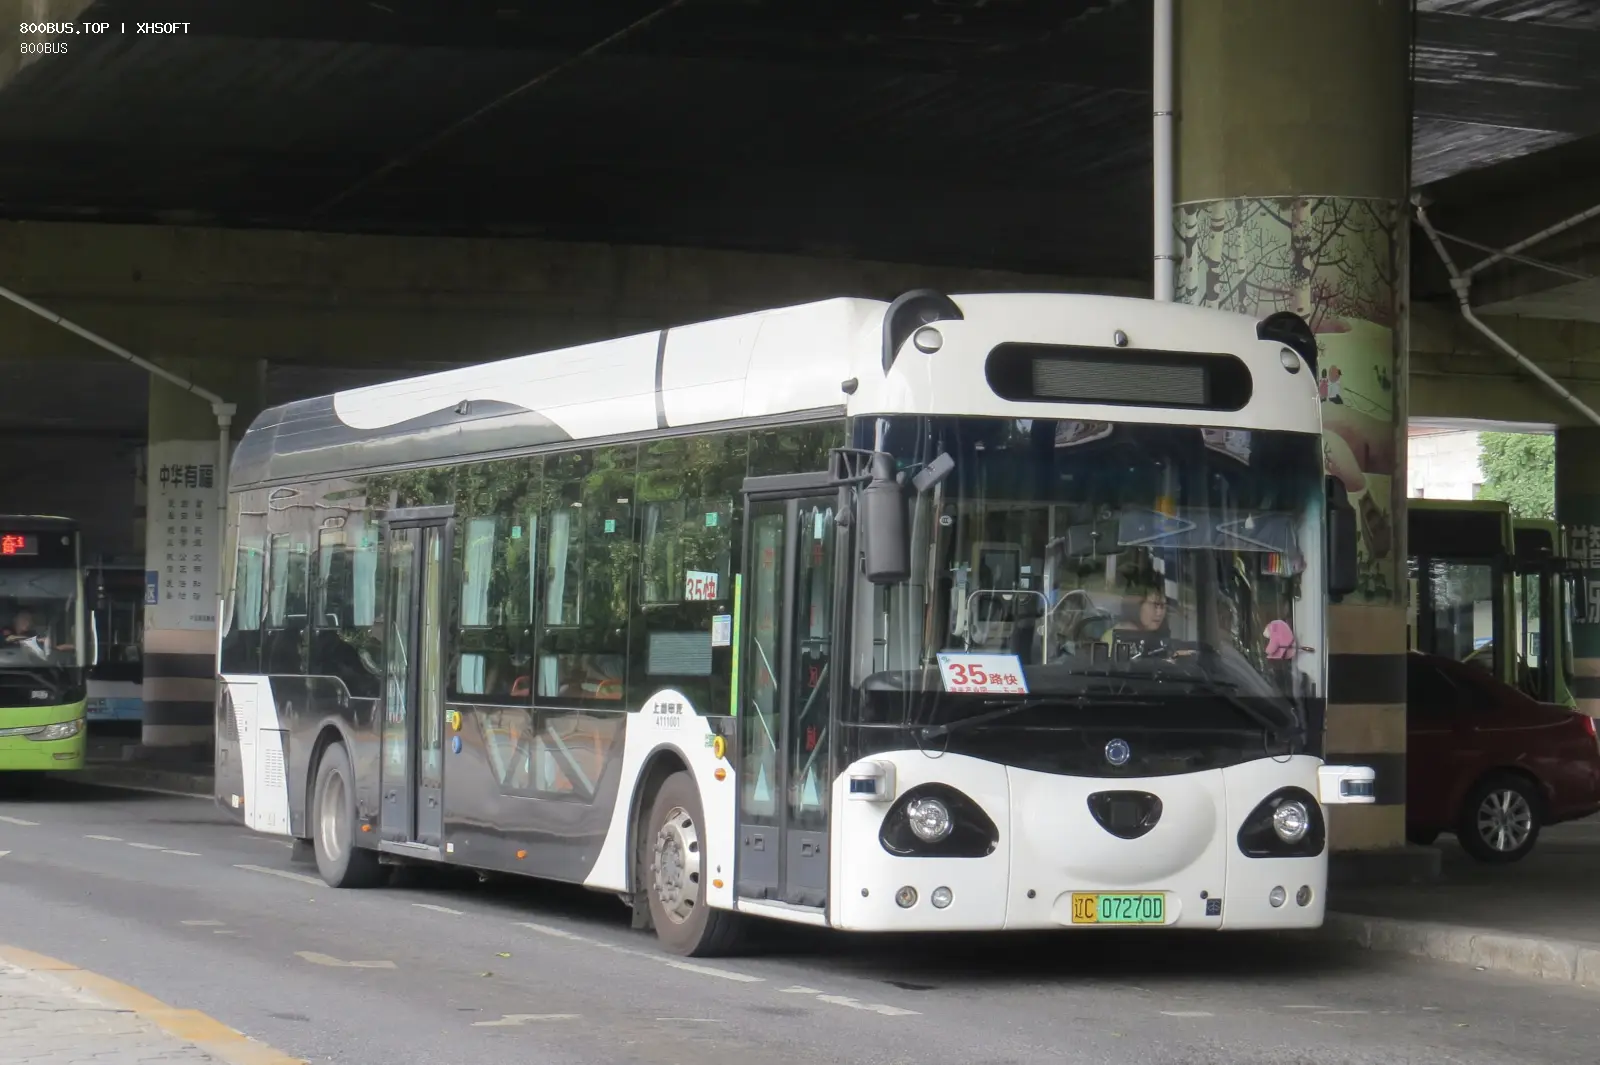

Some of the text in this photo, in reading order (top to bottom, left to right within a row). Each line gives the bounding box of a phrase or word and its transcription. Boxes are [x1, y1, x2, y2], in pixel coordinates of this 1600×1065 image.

[160, 463, 214, 489] 中华有福
[1074, 897, 1163, 919] 辽C 07270D
